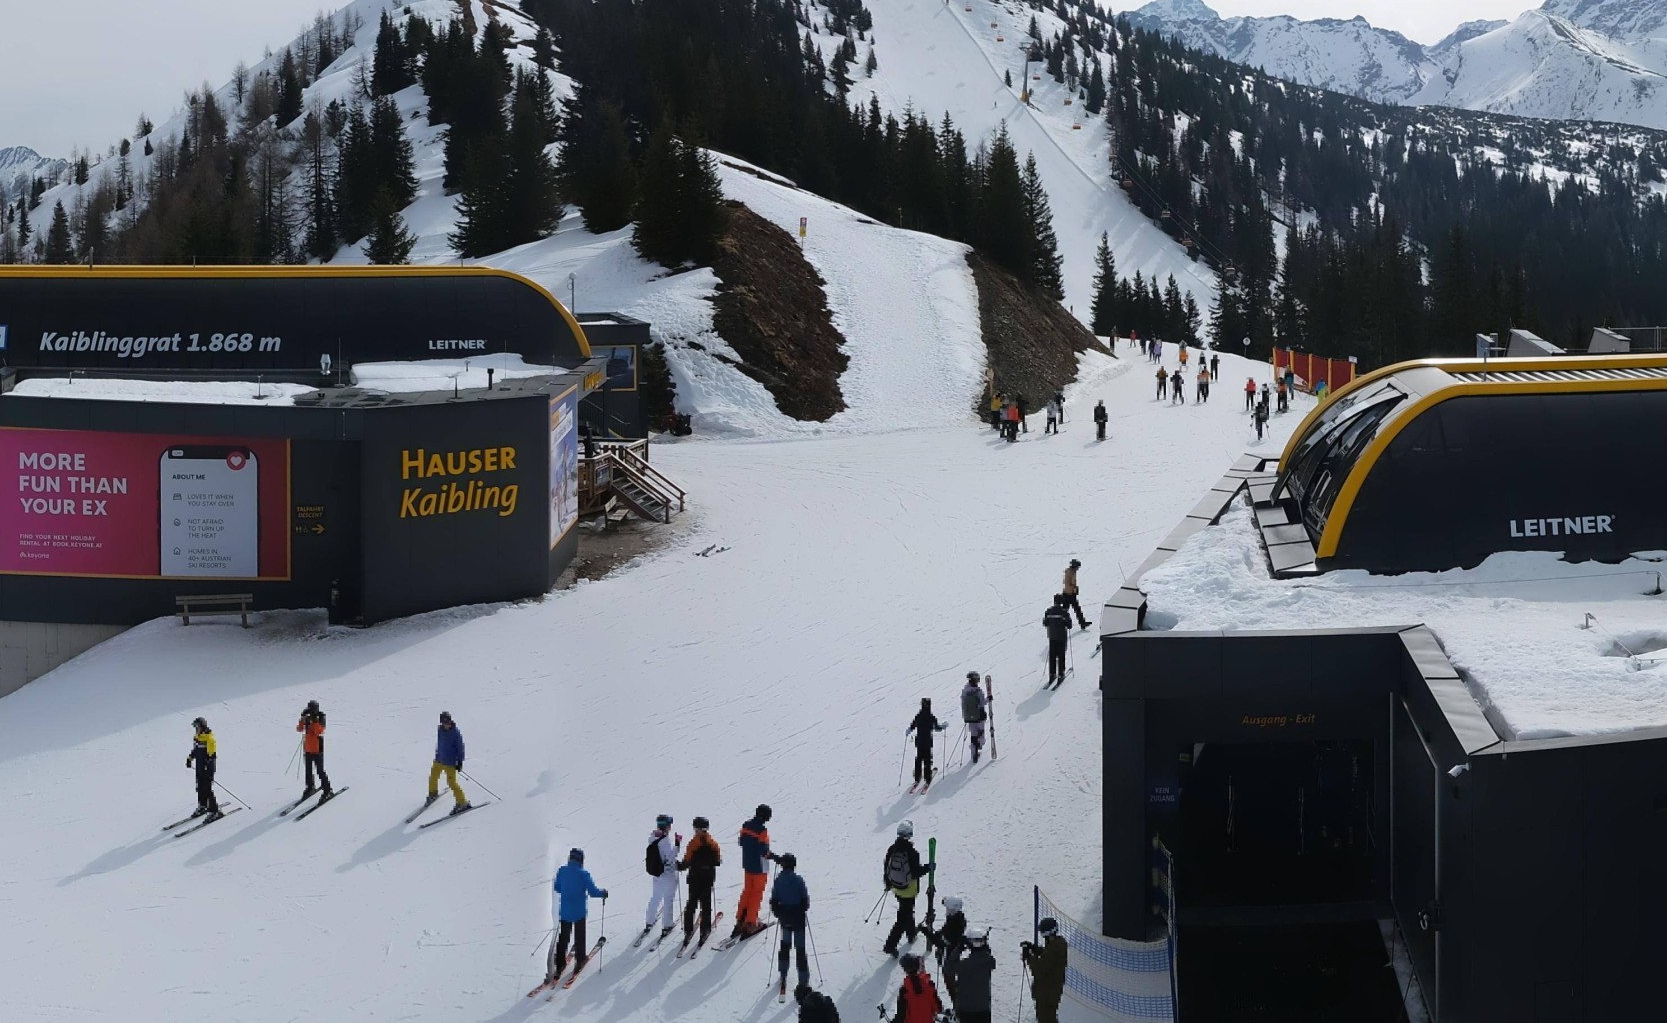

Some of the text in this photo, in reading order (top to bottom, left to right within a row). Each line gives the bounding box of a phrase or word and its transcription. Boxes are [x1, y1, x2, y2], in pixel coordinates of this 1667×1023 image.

[39, 331, 282, 358] Kaiblinggrat 1.868 m
[428, 339, 486, 350] LEITNER
[19, 452, 86, 471] MORE
[402, 446, 516, 480] HAUSER
[19, 476, 127, 494] FUN THAN
[20, 498, 108, 516] YOUR EX
[400, 480, 518, 518] Kaibling
[1510, 515, 1613, 538] LEITNER
[1242, 715, 1287, 726] Ausgang
[1296, 714, 1316, 723] Exit
